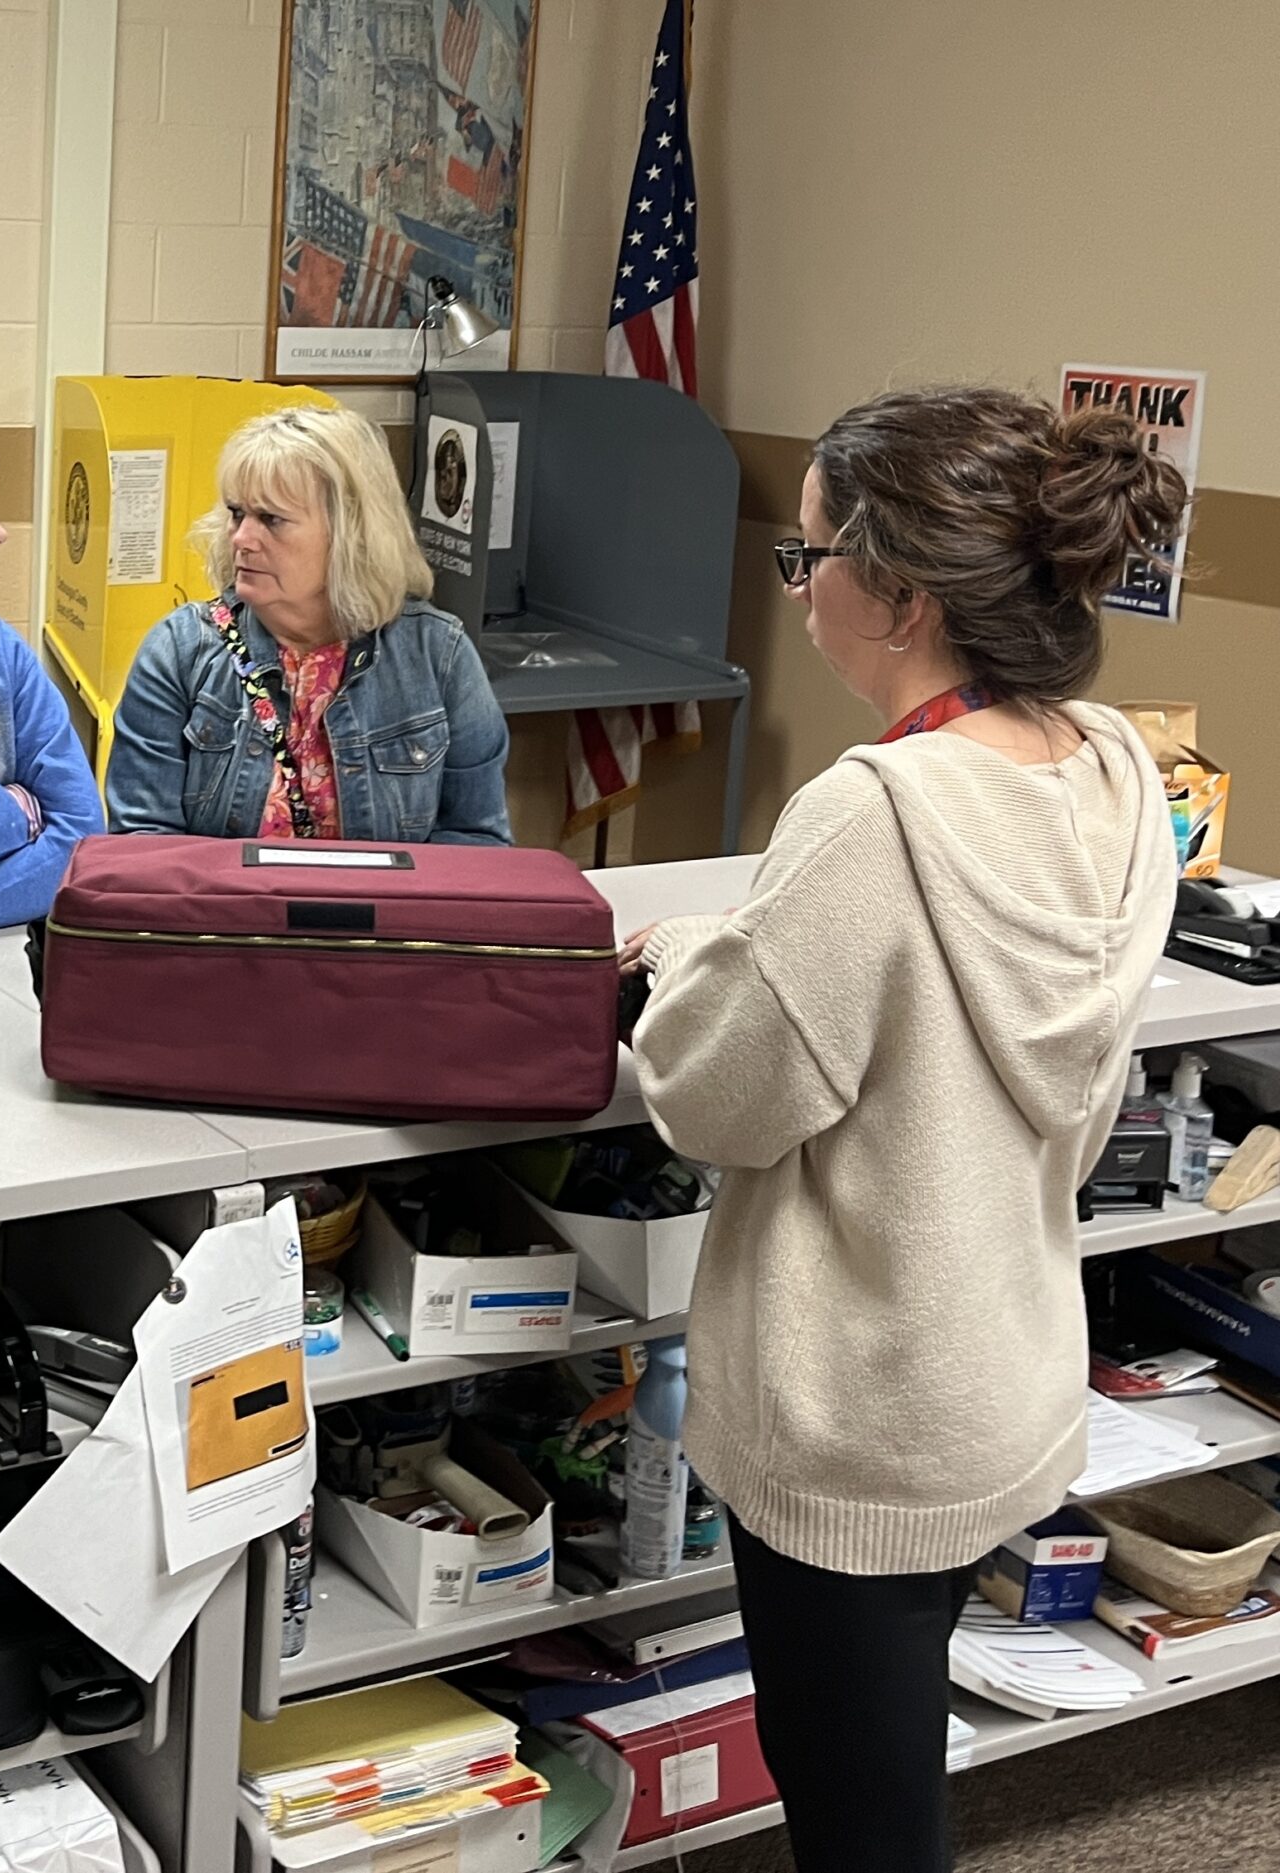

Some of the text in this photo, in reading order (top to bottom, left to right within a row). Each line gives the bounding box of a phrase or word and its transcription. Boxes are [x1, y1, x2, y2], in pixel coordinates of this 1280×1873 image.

[290, 348, 328, 359] CHILDE
[331, 348, 373, 359] HASSAM
[1068, 378, 1191, 428] THANK
[38, 1759, 69, 1791] HAM
